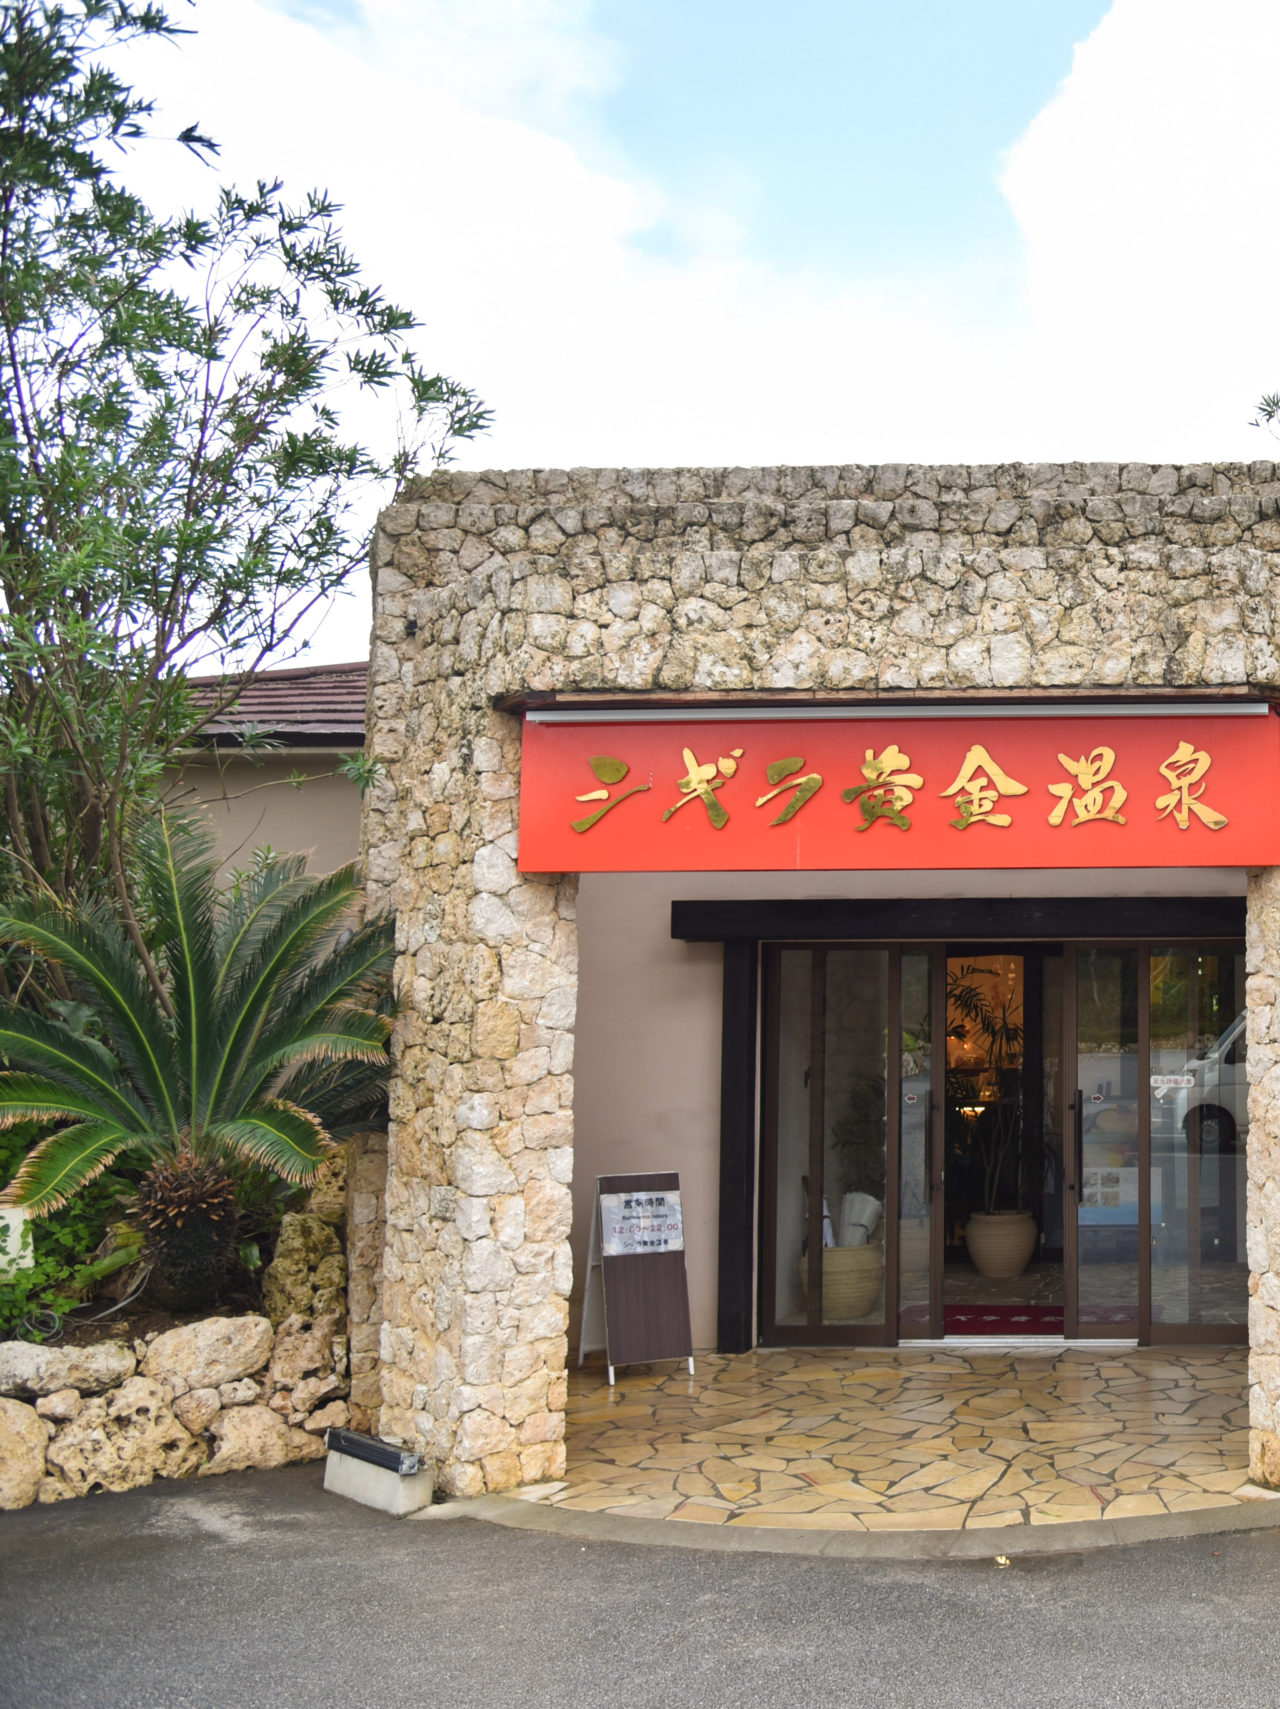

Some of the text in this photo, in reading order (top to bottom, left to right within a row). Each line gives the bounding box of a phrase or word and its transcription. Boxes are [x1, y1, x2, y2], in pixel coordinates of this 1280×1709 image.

[569, 740, 1230, 834] シギラ黄金温泉
[624, 1198, 665, 1209] 営業時間
